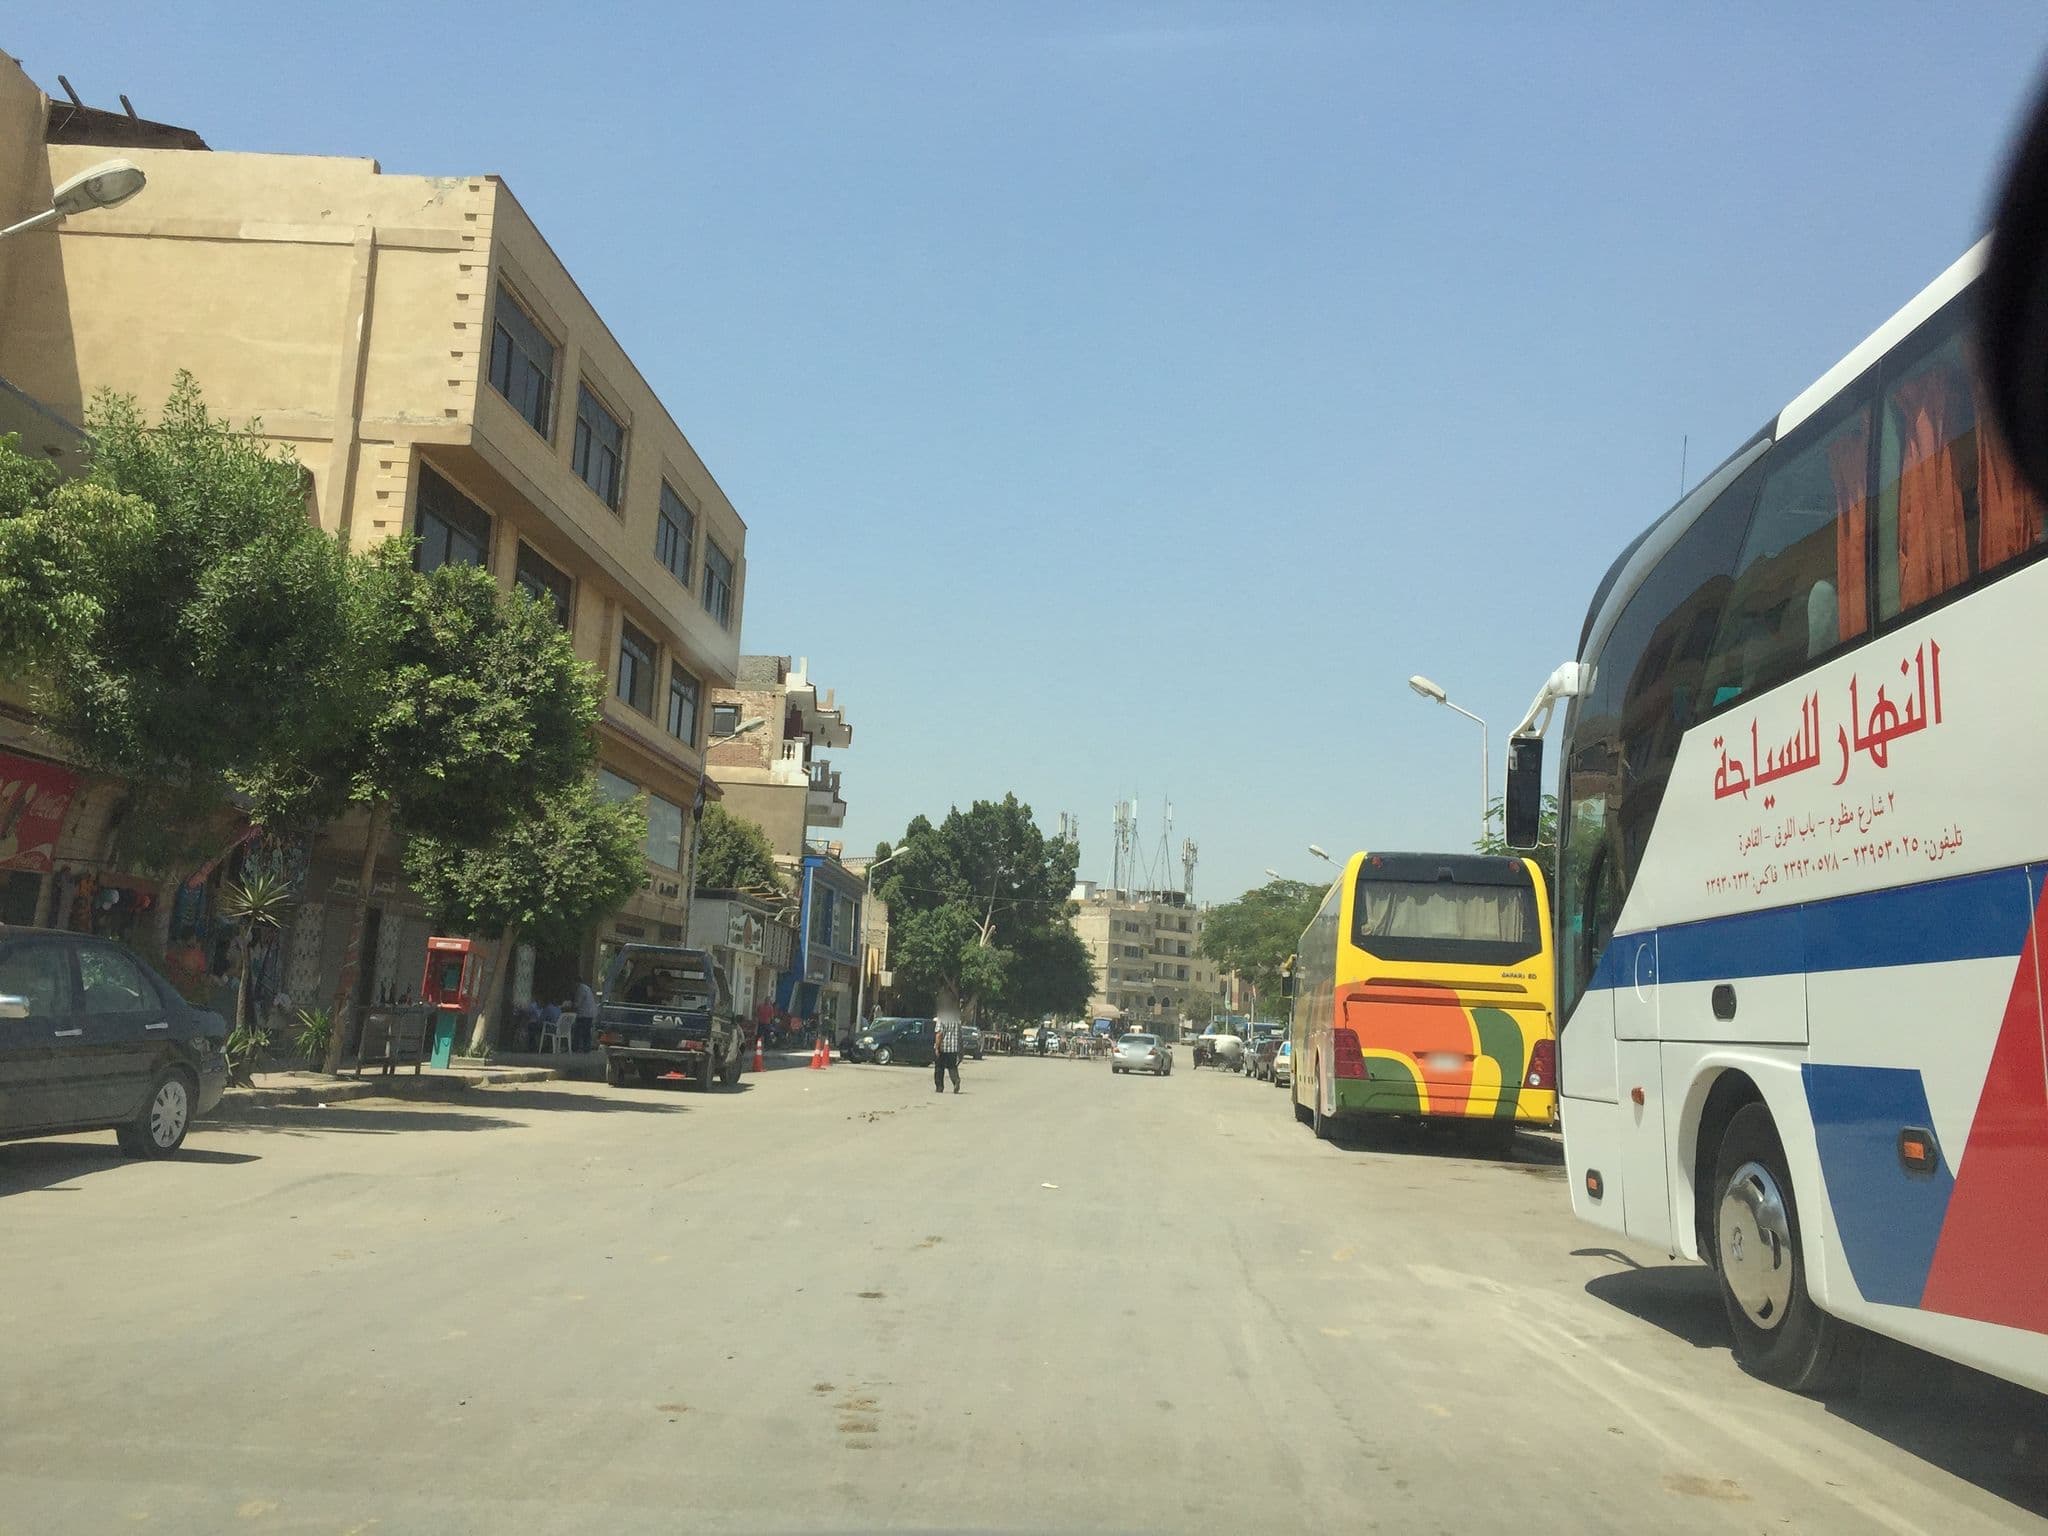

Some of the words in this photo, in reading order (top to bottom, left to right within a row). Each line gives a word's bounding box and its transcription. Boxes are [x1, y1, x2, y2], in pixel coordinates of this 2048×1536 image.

[1832, 638, 1942, 786] النهار
[1714, 690, 1820, 810] للسياحة
[1798, 811, 1816, 842] باب
[1857, 792, 1885, 834] شارع
[1738, 825, 1763, 856] القاهرة
[1774, 816, 1796, 848] اللوق
